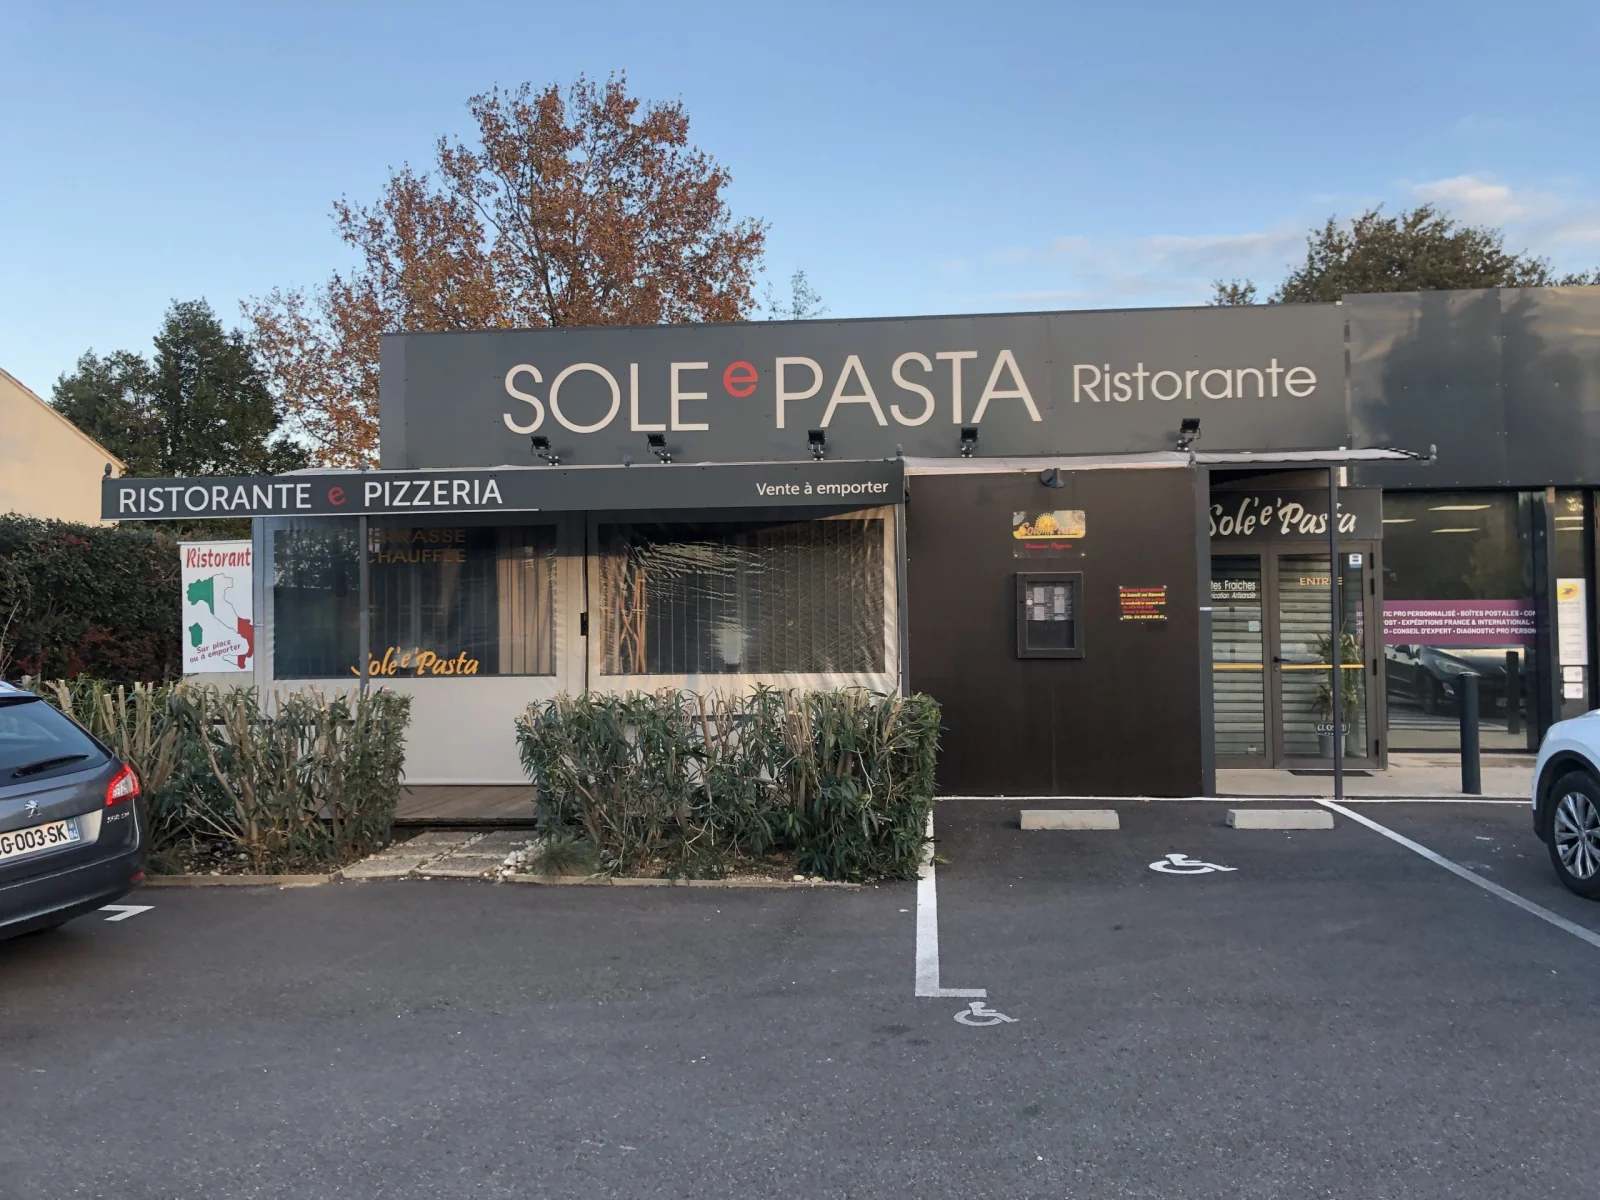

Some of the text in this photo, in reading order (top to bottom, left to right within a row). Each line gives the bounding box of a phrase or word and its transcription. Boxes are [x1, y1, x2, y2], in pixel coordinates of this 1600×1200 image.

[503, 350, 1317, 434] SOLE e PASTA Ristorante
[119, 479, 503, 513] RISTORANTE e PIZZERIA
[756, 481, 889, 497] Vente à emporter
[368, 527, 466, 544] ERRASSE
[186, 547, 251, 569] Ristorant
[1299, 577, 1343, 586] ENTRE
[1407, 609, 1456, 617] PERSONNALISÉ
[1401, 618, 1444, 626] EXPÉDITIONS
[196, 639, 231, 654] Sur place
[208, 644, 241, 657] emporter
[415, 650, 480, 676] Pasta
[0, 823, 68, 855] G-003-SK
